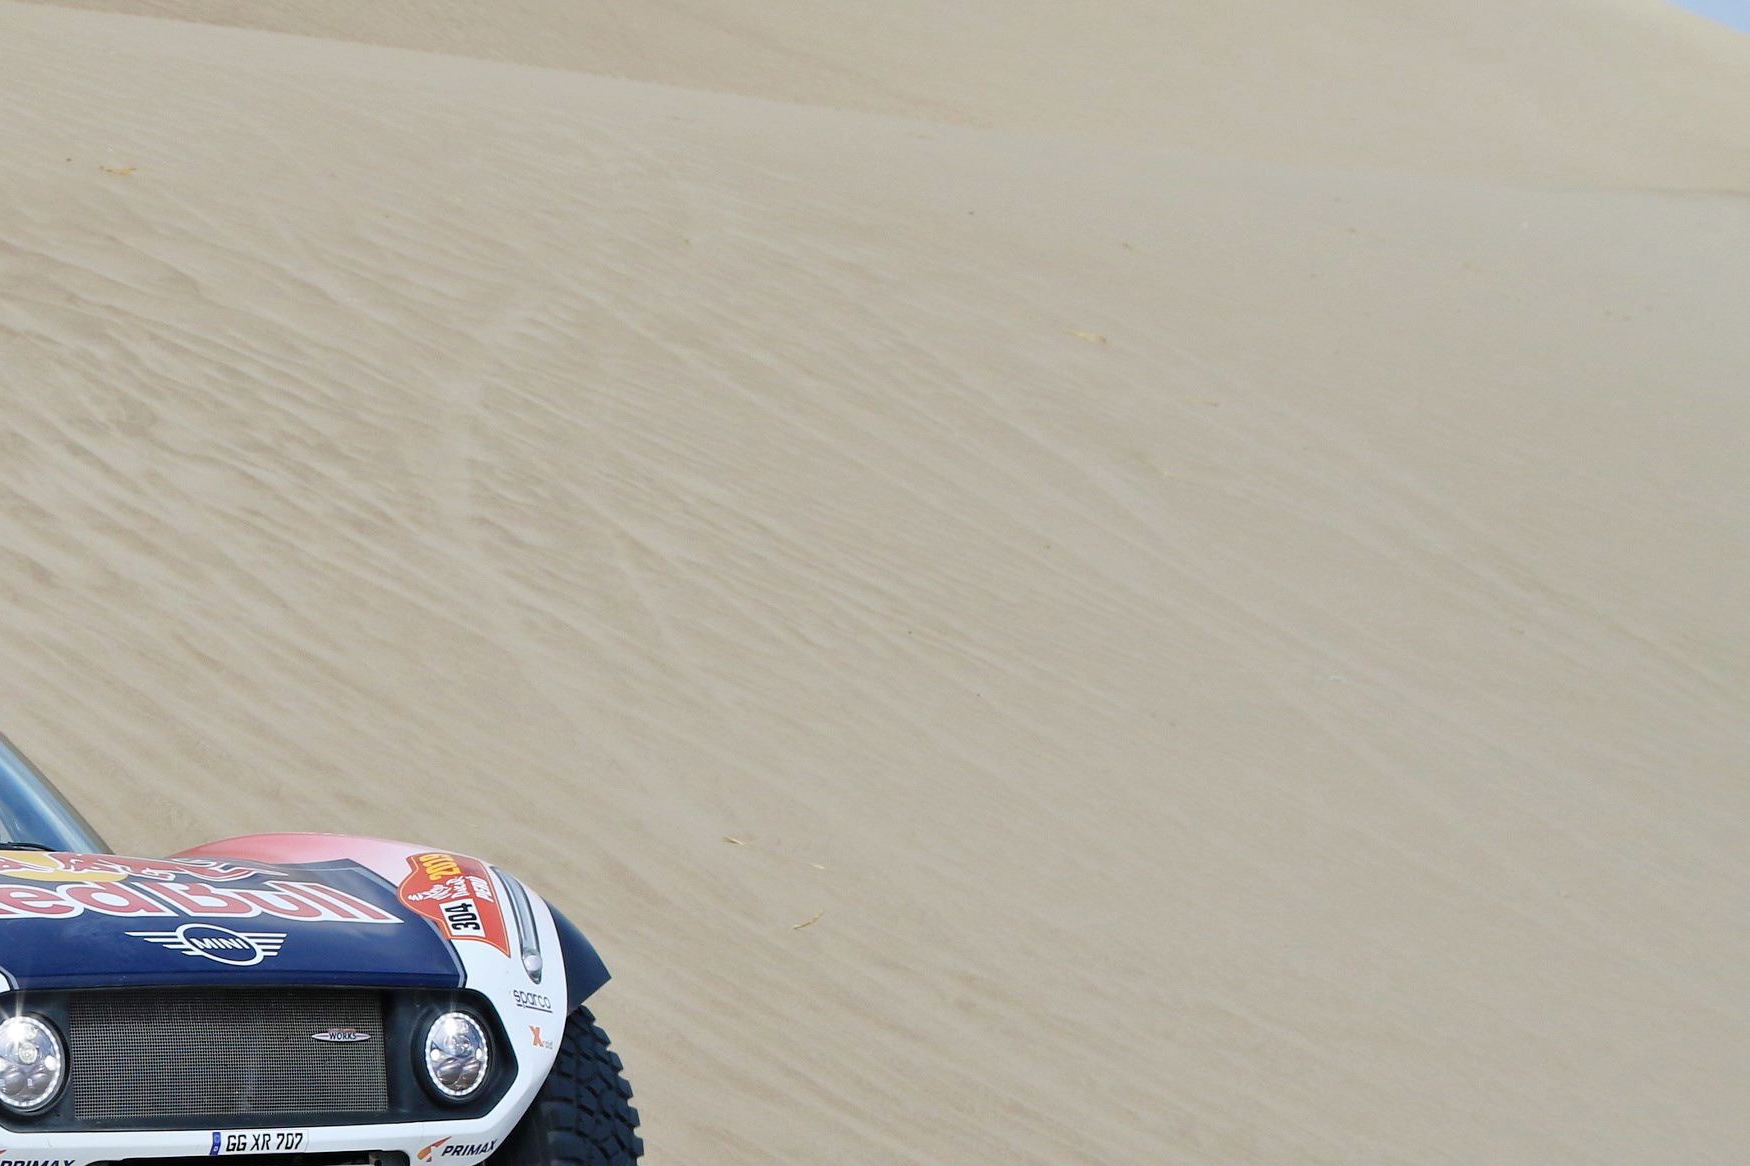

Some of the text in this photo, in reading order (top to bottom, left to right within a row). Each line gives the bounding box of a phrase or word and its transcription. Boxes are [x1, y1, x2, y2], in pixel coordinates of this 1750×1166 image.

[419, 853, 462, 881] 2019
[444, 902, 481, 931] 304
[189, 936, 250, 950] MINI
[513, 989, 553, 1013] sparco
[330, 1032, 357, 1040] WORKS
[226, 1132, 304, 1152] GG XR 707
[441, 1138, 497, 1157] PRIMAX
